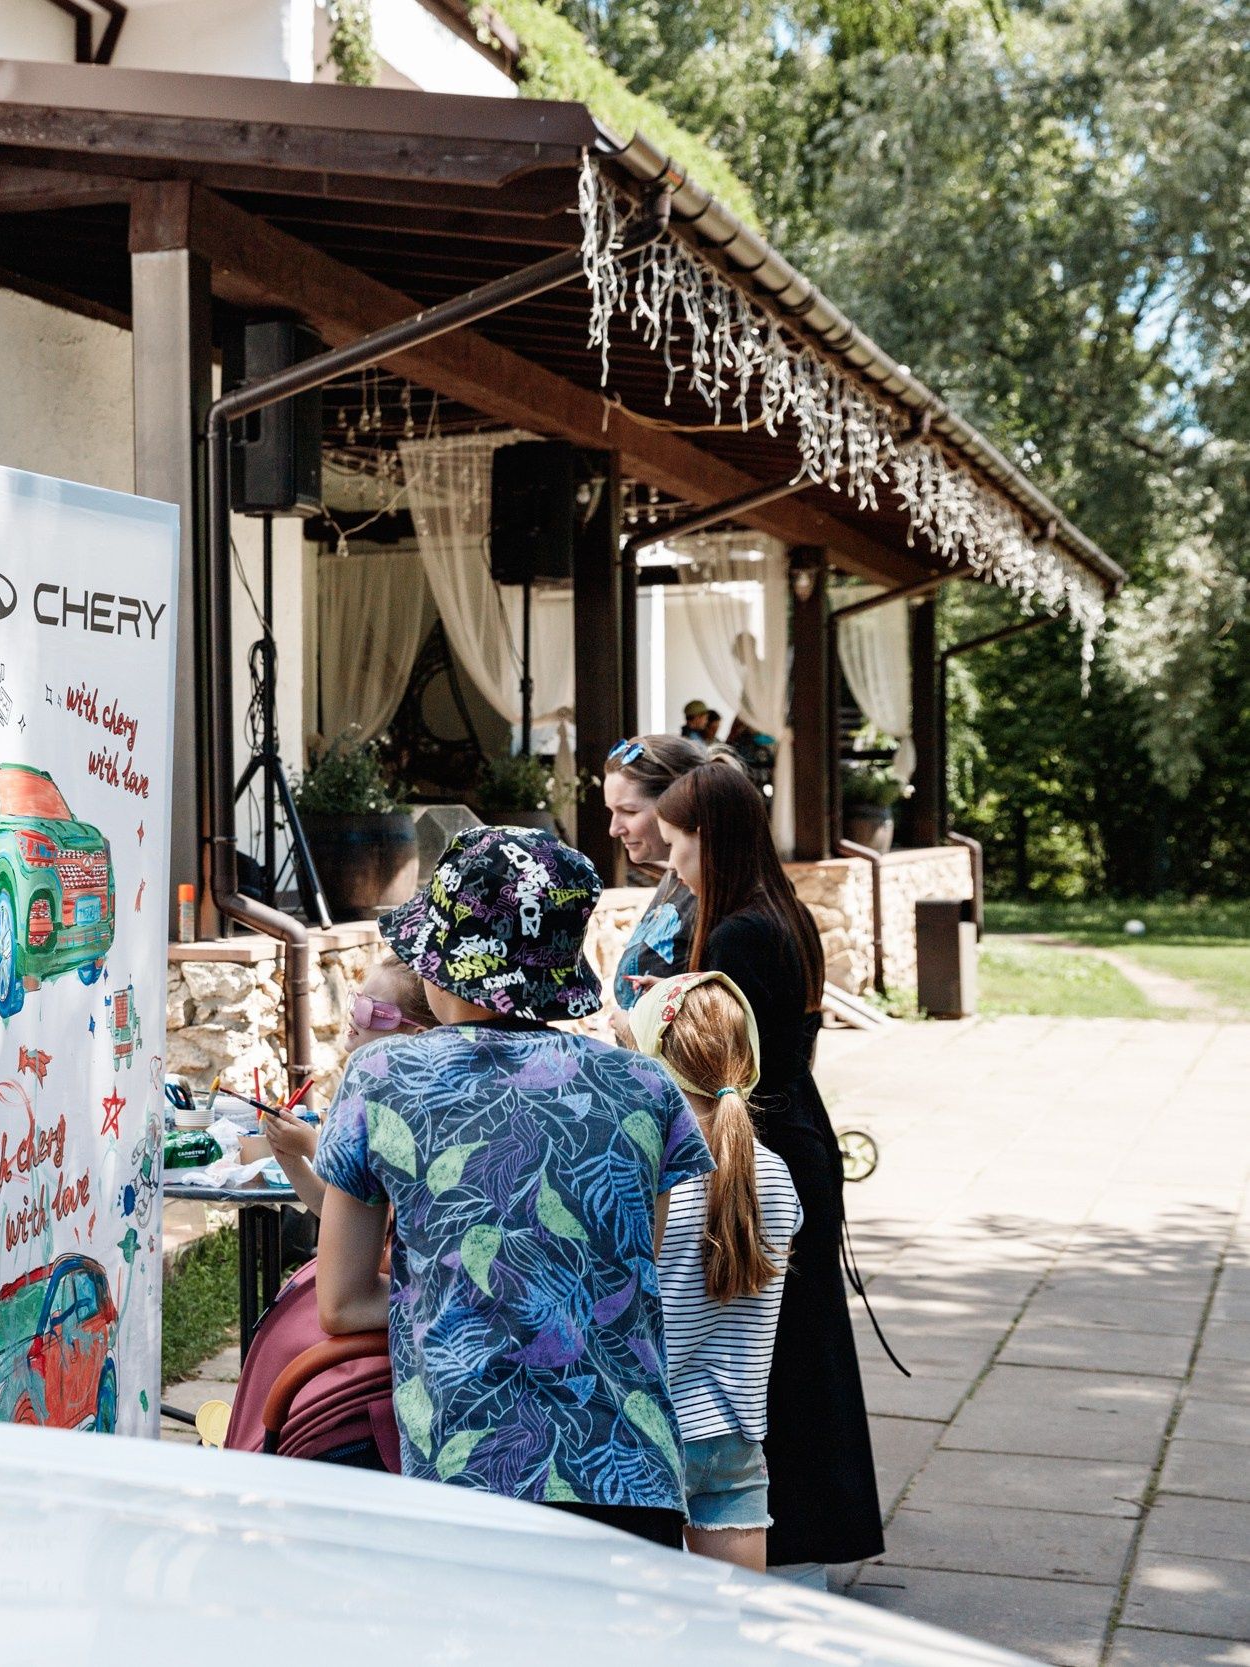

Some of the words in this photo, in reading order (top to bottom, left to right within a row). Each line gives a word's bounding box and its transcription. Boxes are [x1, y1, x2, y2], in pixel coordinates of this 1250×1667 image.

[33, 583, 166, 640] CHERY
[66, 682, 99, 724] with
[102, 698, 138, 752] chery
[88, 746, 119, 787] with
[122, 756, 149, 799] love
[16, 1113, 66, 1173] chery
[5, 1184, 50, 1251] with
[52, 1171, 90, 1221] love
